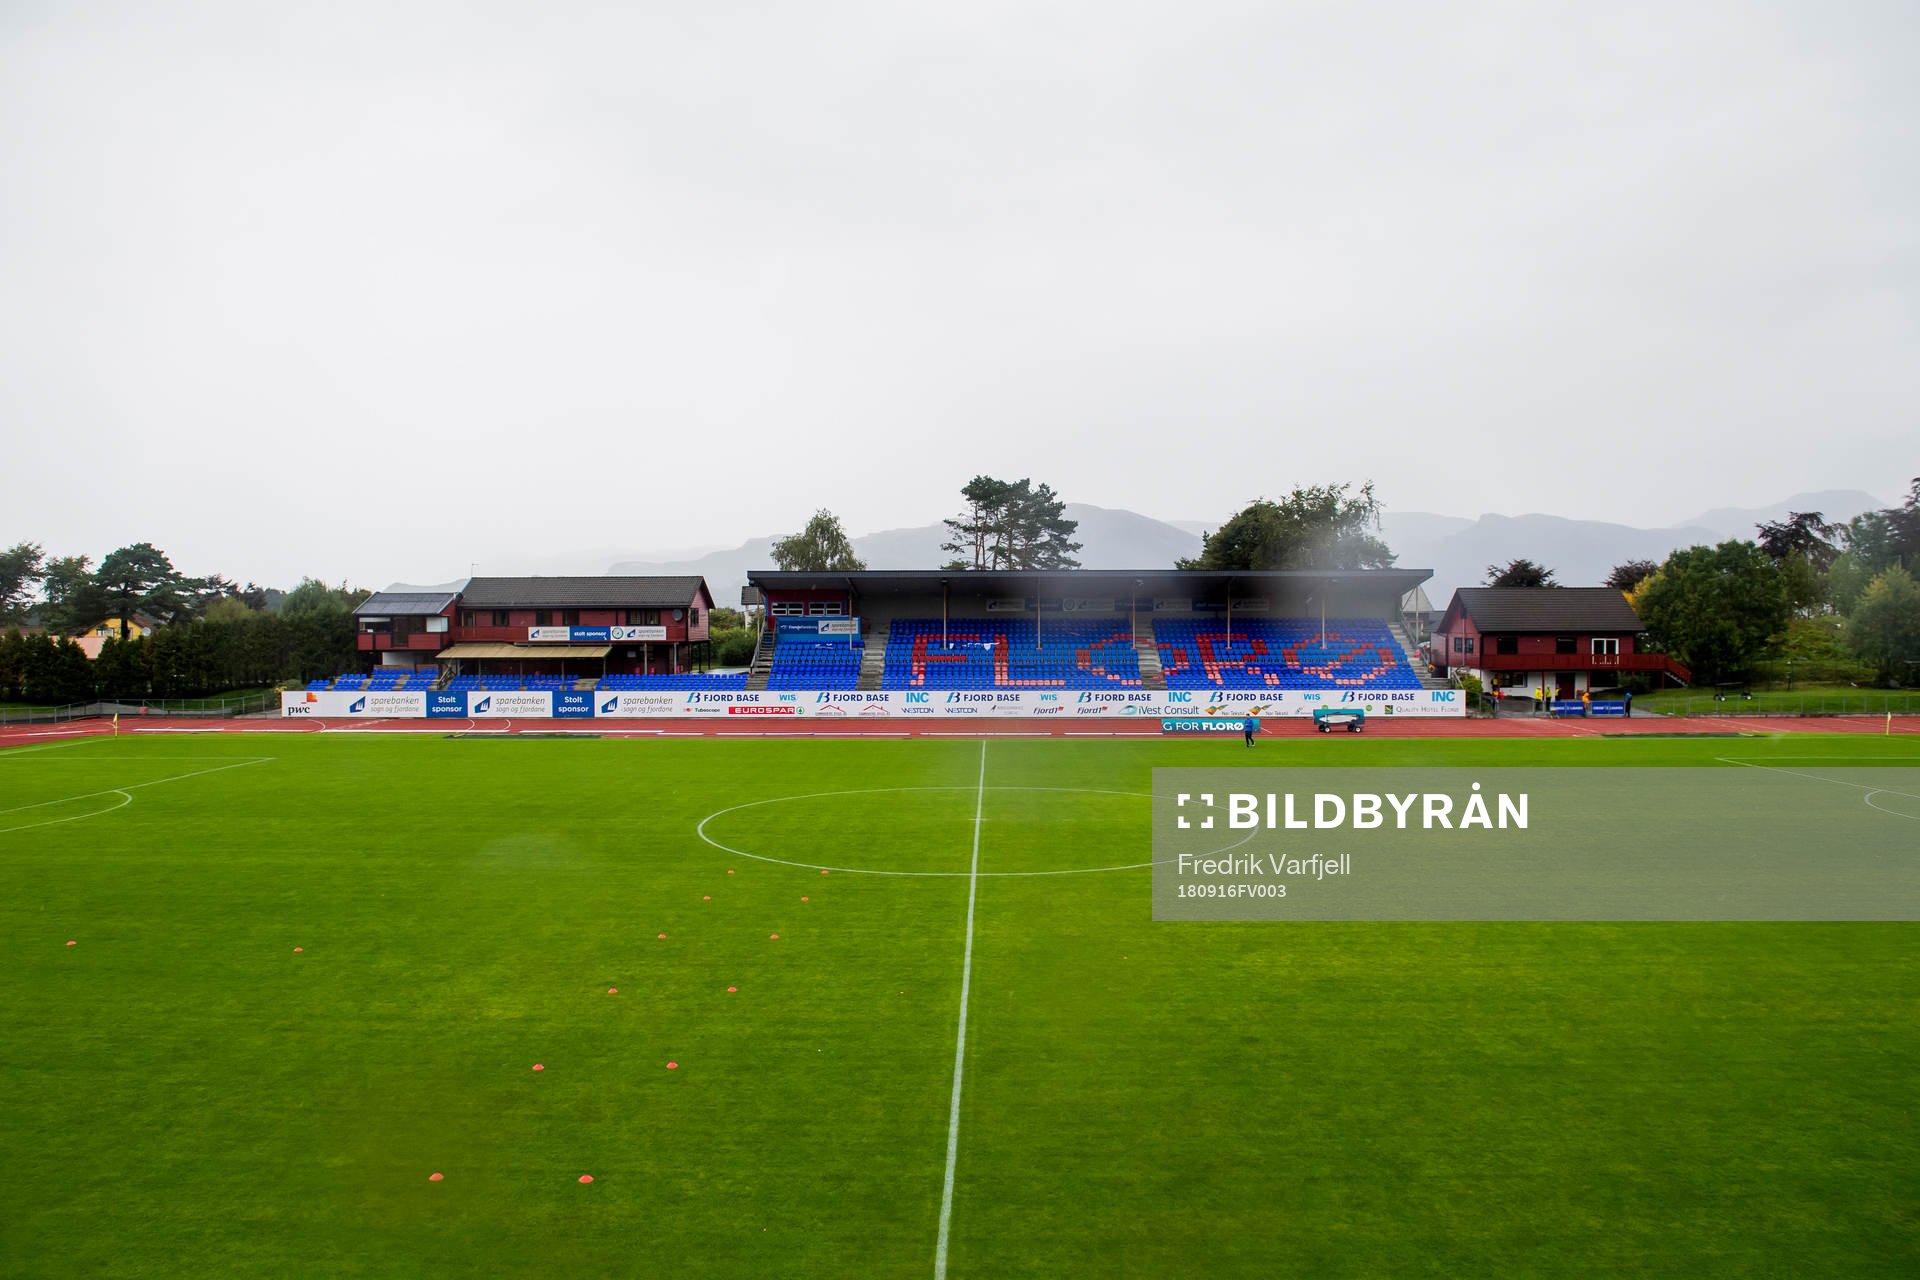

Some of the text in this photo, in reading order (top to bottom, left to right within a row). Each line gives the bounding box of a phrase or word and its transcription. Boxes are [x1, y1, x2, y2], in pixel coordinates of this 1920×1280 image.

[370, 696, 419, 705] sparebanken
[496, 696, 545, 705] sparebanken
[623, 696, 673, 705] sparebanken
[906, 693, 929, 703] INC
[1168, 692, 1192, 702] INC
[1226, 693, 1283, 701] FJORD BASE
[1358, 693, 1414, 701] FJORD BASE
[1432, 691, 1455, 702] INC
[288, 706, 310, 715] pwc
[1139, 706, 1199, 714] iVest Consult
[1176, 722, 1199, 731] FOR
[1202, 722, 1244, 731] FLORØ
